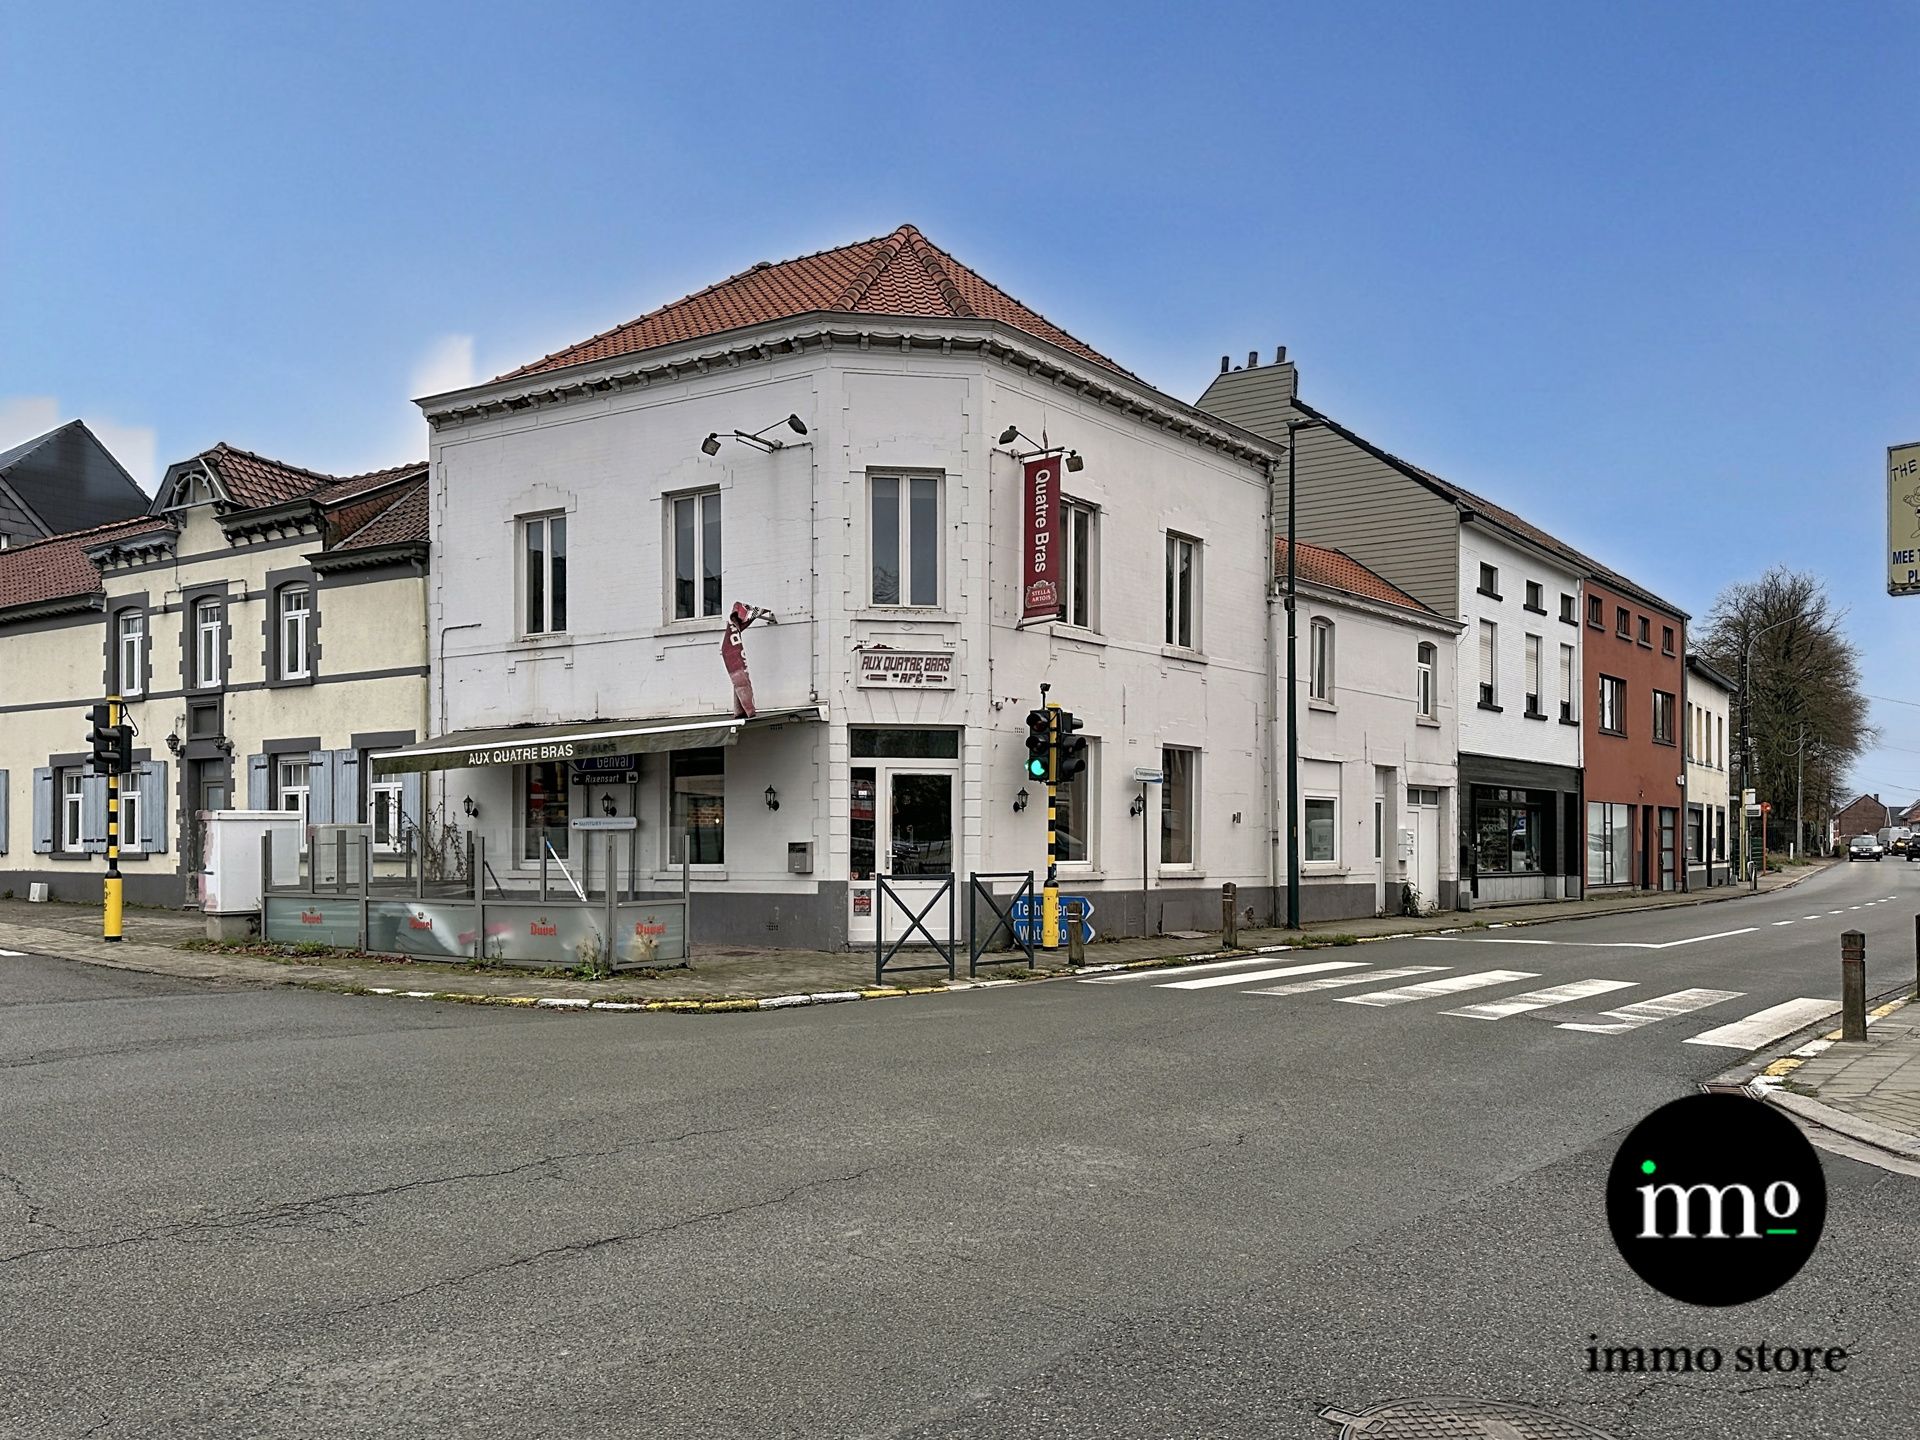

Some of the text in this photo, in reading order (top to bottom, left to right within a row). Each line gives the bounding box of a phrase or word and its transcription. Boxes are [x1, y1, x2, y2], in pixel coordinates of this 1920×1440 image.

[1891, 458, 1917, 481] THE
[1034, 468, 1051, 573] Quatre Bras
[1892, 549, 1915, 565] MEE
[1031, 589, 1051, 597] STELLA
[861, 655, 951, 672] AUX QUATRE BRAS
[468, 751, 490, 765] AUX
[493, 747, 538, 763] QUATRE
[541, 743, 574, 759] BRAS
[596, 755, 629, 768] Genval
[585, 773, 620, 783] Rixensart
[530, 922, 557, 936] Duvel
